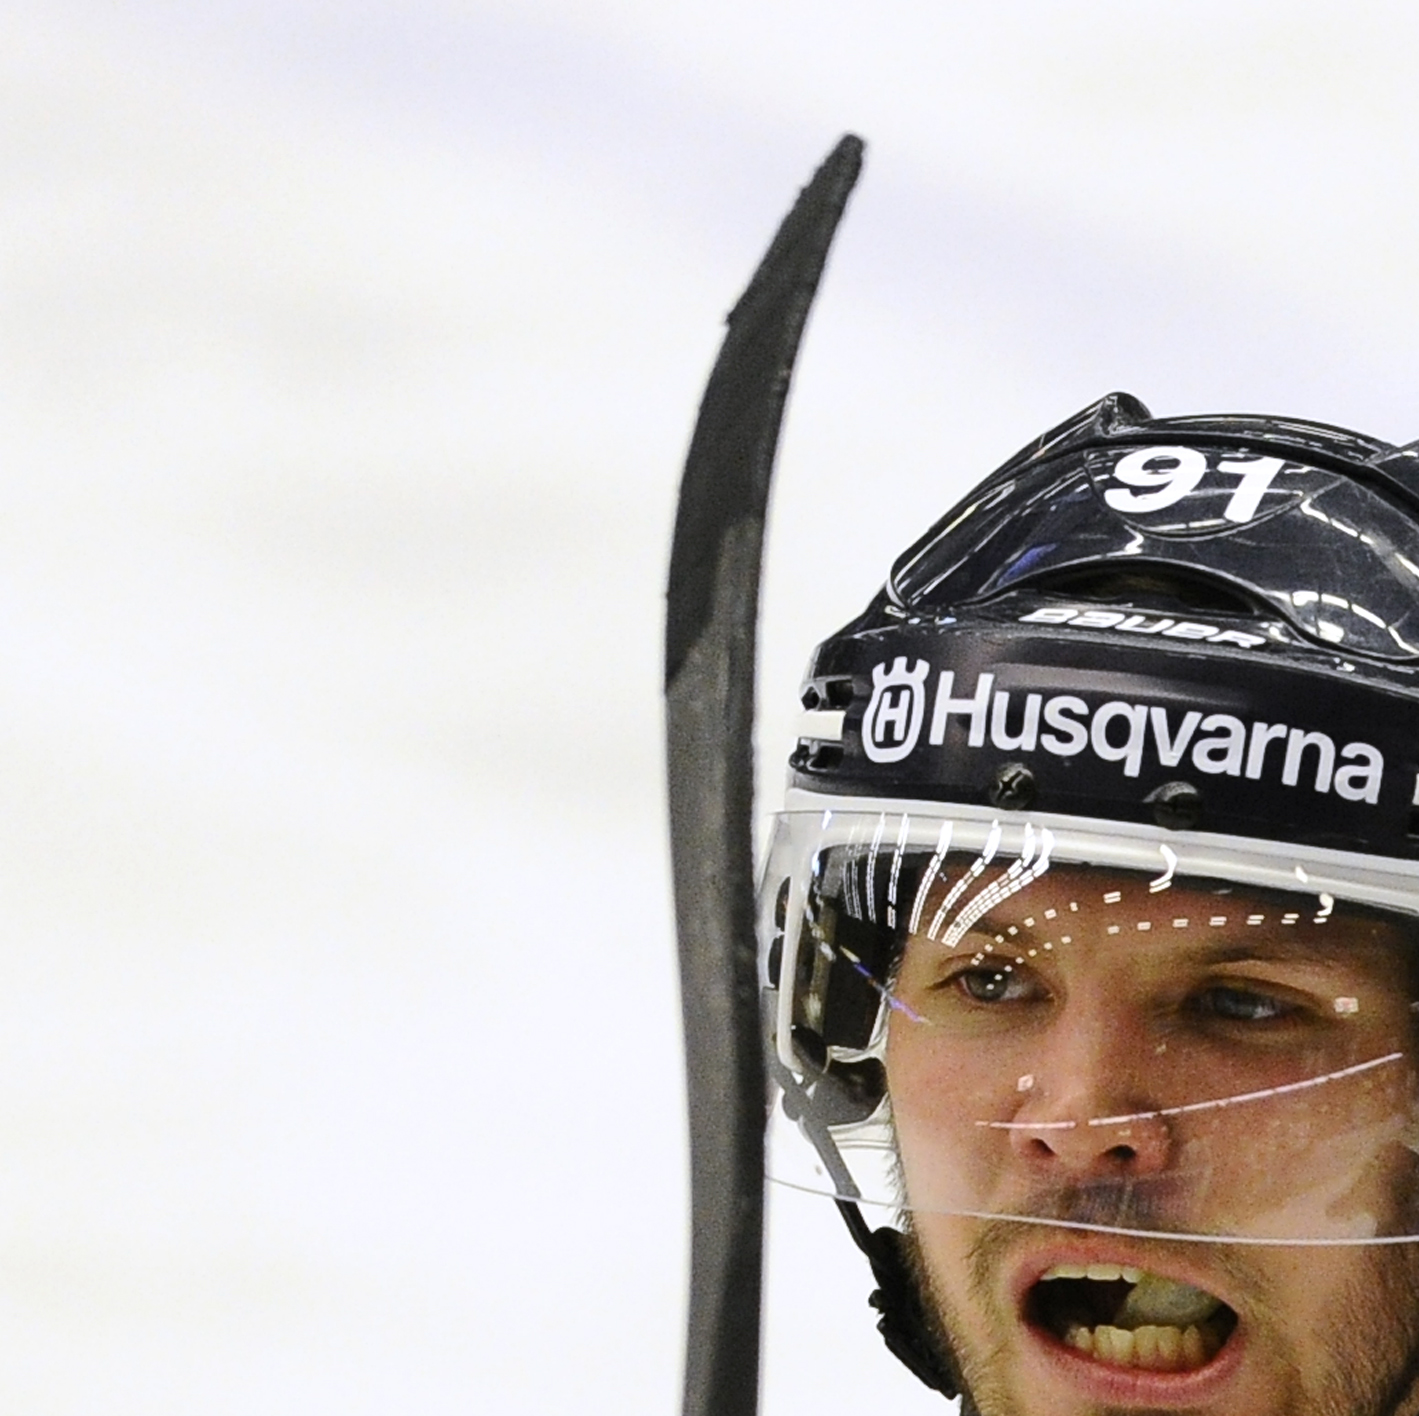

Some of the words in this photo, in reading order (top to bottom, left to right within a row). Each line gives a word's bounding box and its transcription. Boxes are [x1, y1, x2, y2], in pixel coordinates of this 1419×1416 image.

[1104, 445, 1286, 524] 91
[1018, 607, 1267, 649] BAUER
[928, 669, 1385, 805] Husqvarna
